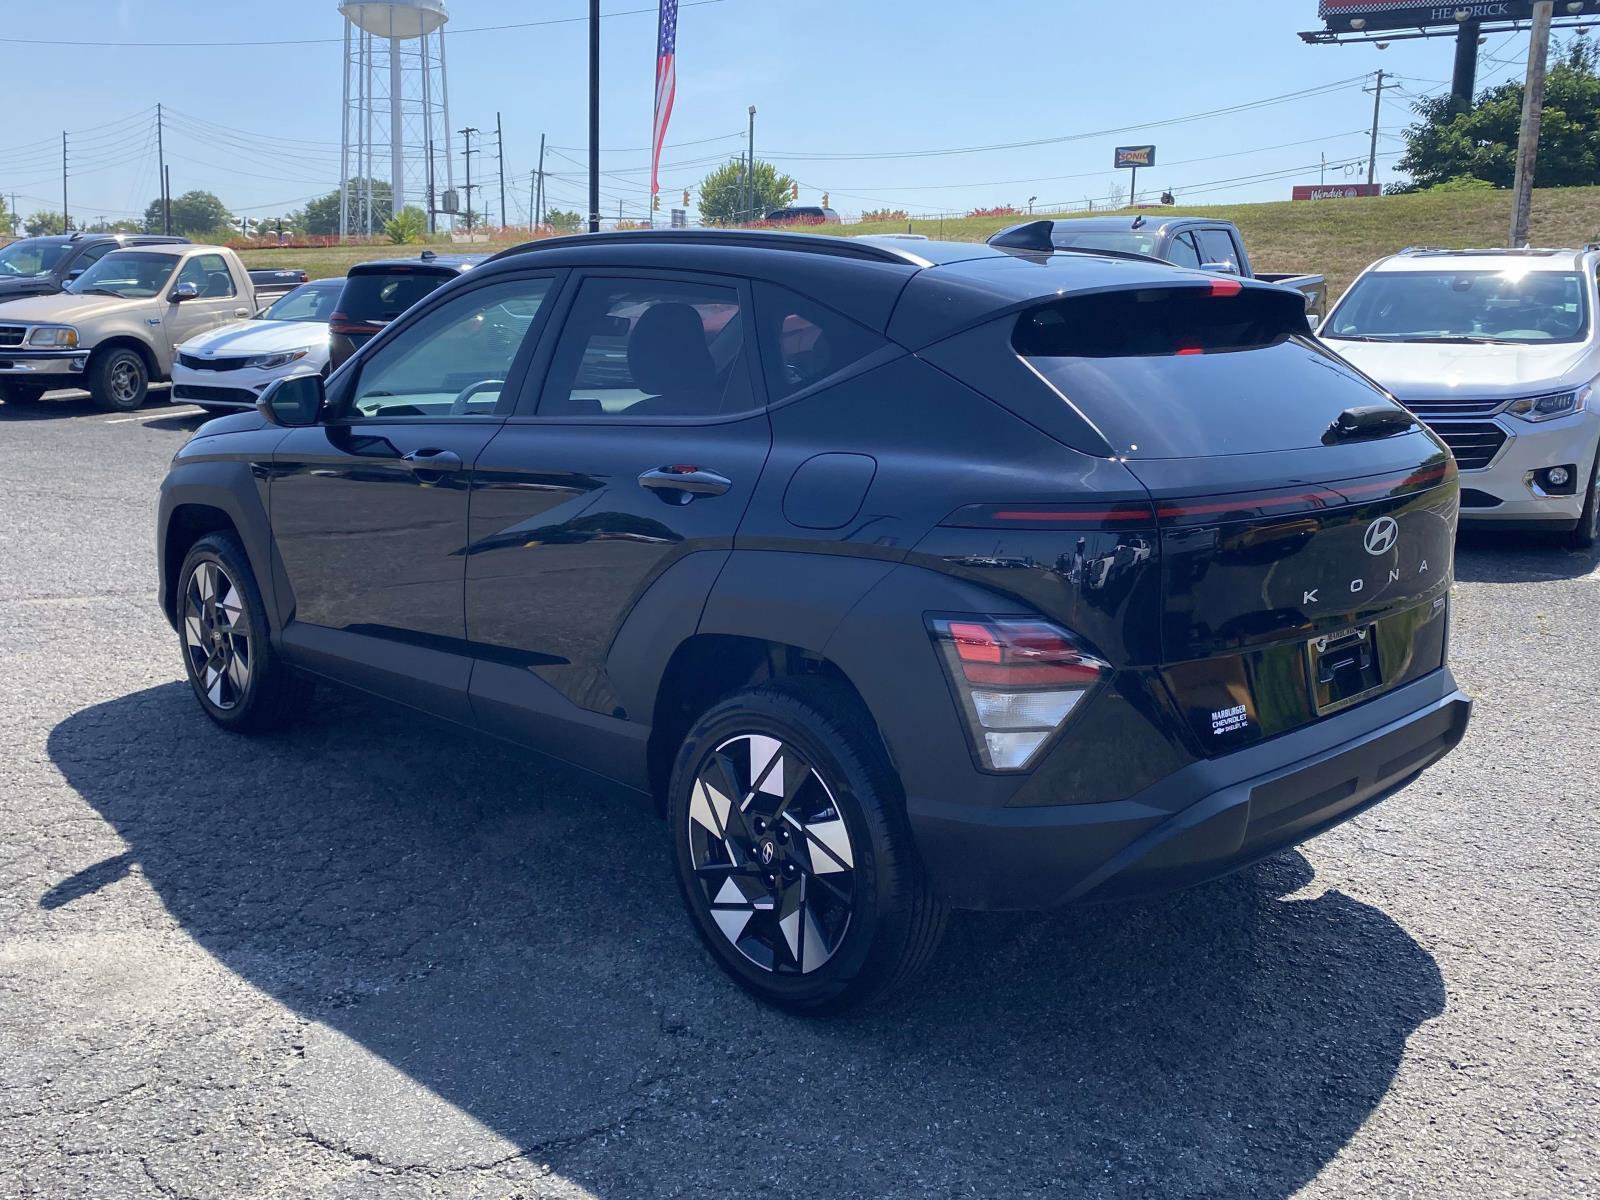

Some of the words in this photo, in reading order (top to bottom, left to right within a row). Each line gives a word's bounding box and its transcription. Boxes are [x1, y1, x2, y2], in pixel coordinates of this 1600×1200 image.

[1118, 151, 1148, 161] SONIC
[1311, 187, 1343, 200] Wendy's
[1303, 560, 1428, 604] KONA
[1211, 704, 1246, 720] MARBURGER
[1212, 714, 1247, 728] CHEVROLET
